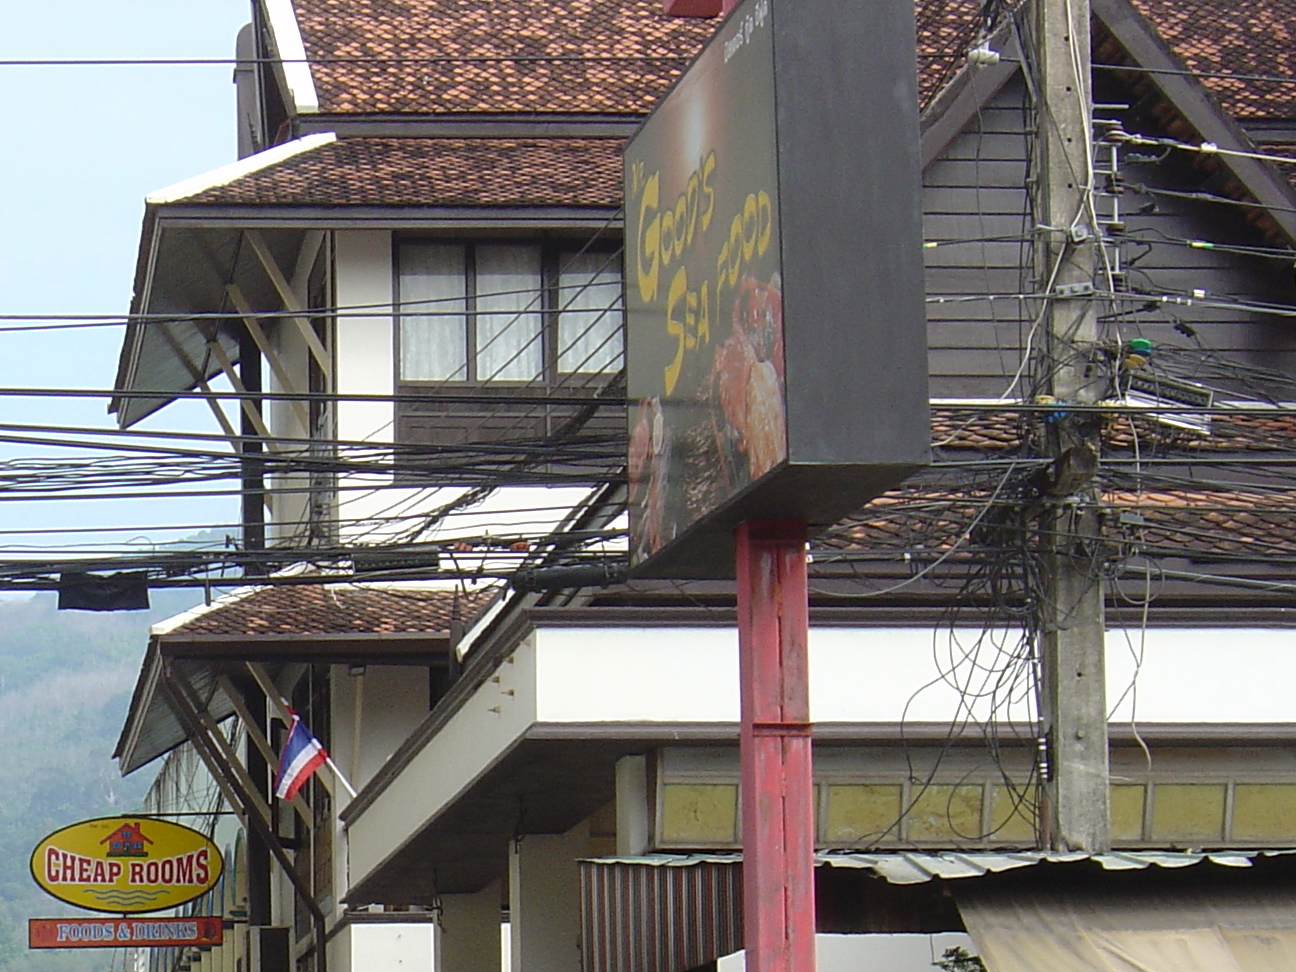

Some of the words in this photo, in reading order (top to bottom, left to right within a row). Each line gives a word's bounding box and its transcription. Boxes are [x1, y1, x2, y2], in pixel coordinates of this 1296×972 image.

[637, 151, 716, 303] GOOD'S
[664, 265, 710, 397] SEA
[716, 189, 772, 327] FOOD
[45, 846, 123, 885] CHEAP
[128, 848, 210, 885] ROOMS
[56, 922, 115, 941] FOODS
[117, 924, 130, 941] &
[132, 921, 198, 940] DRINKS
